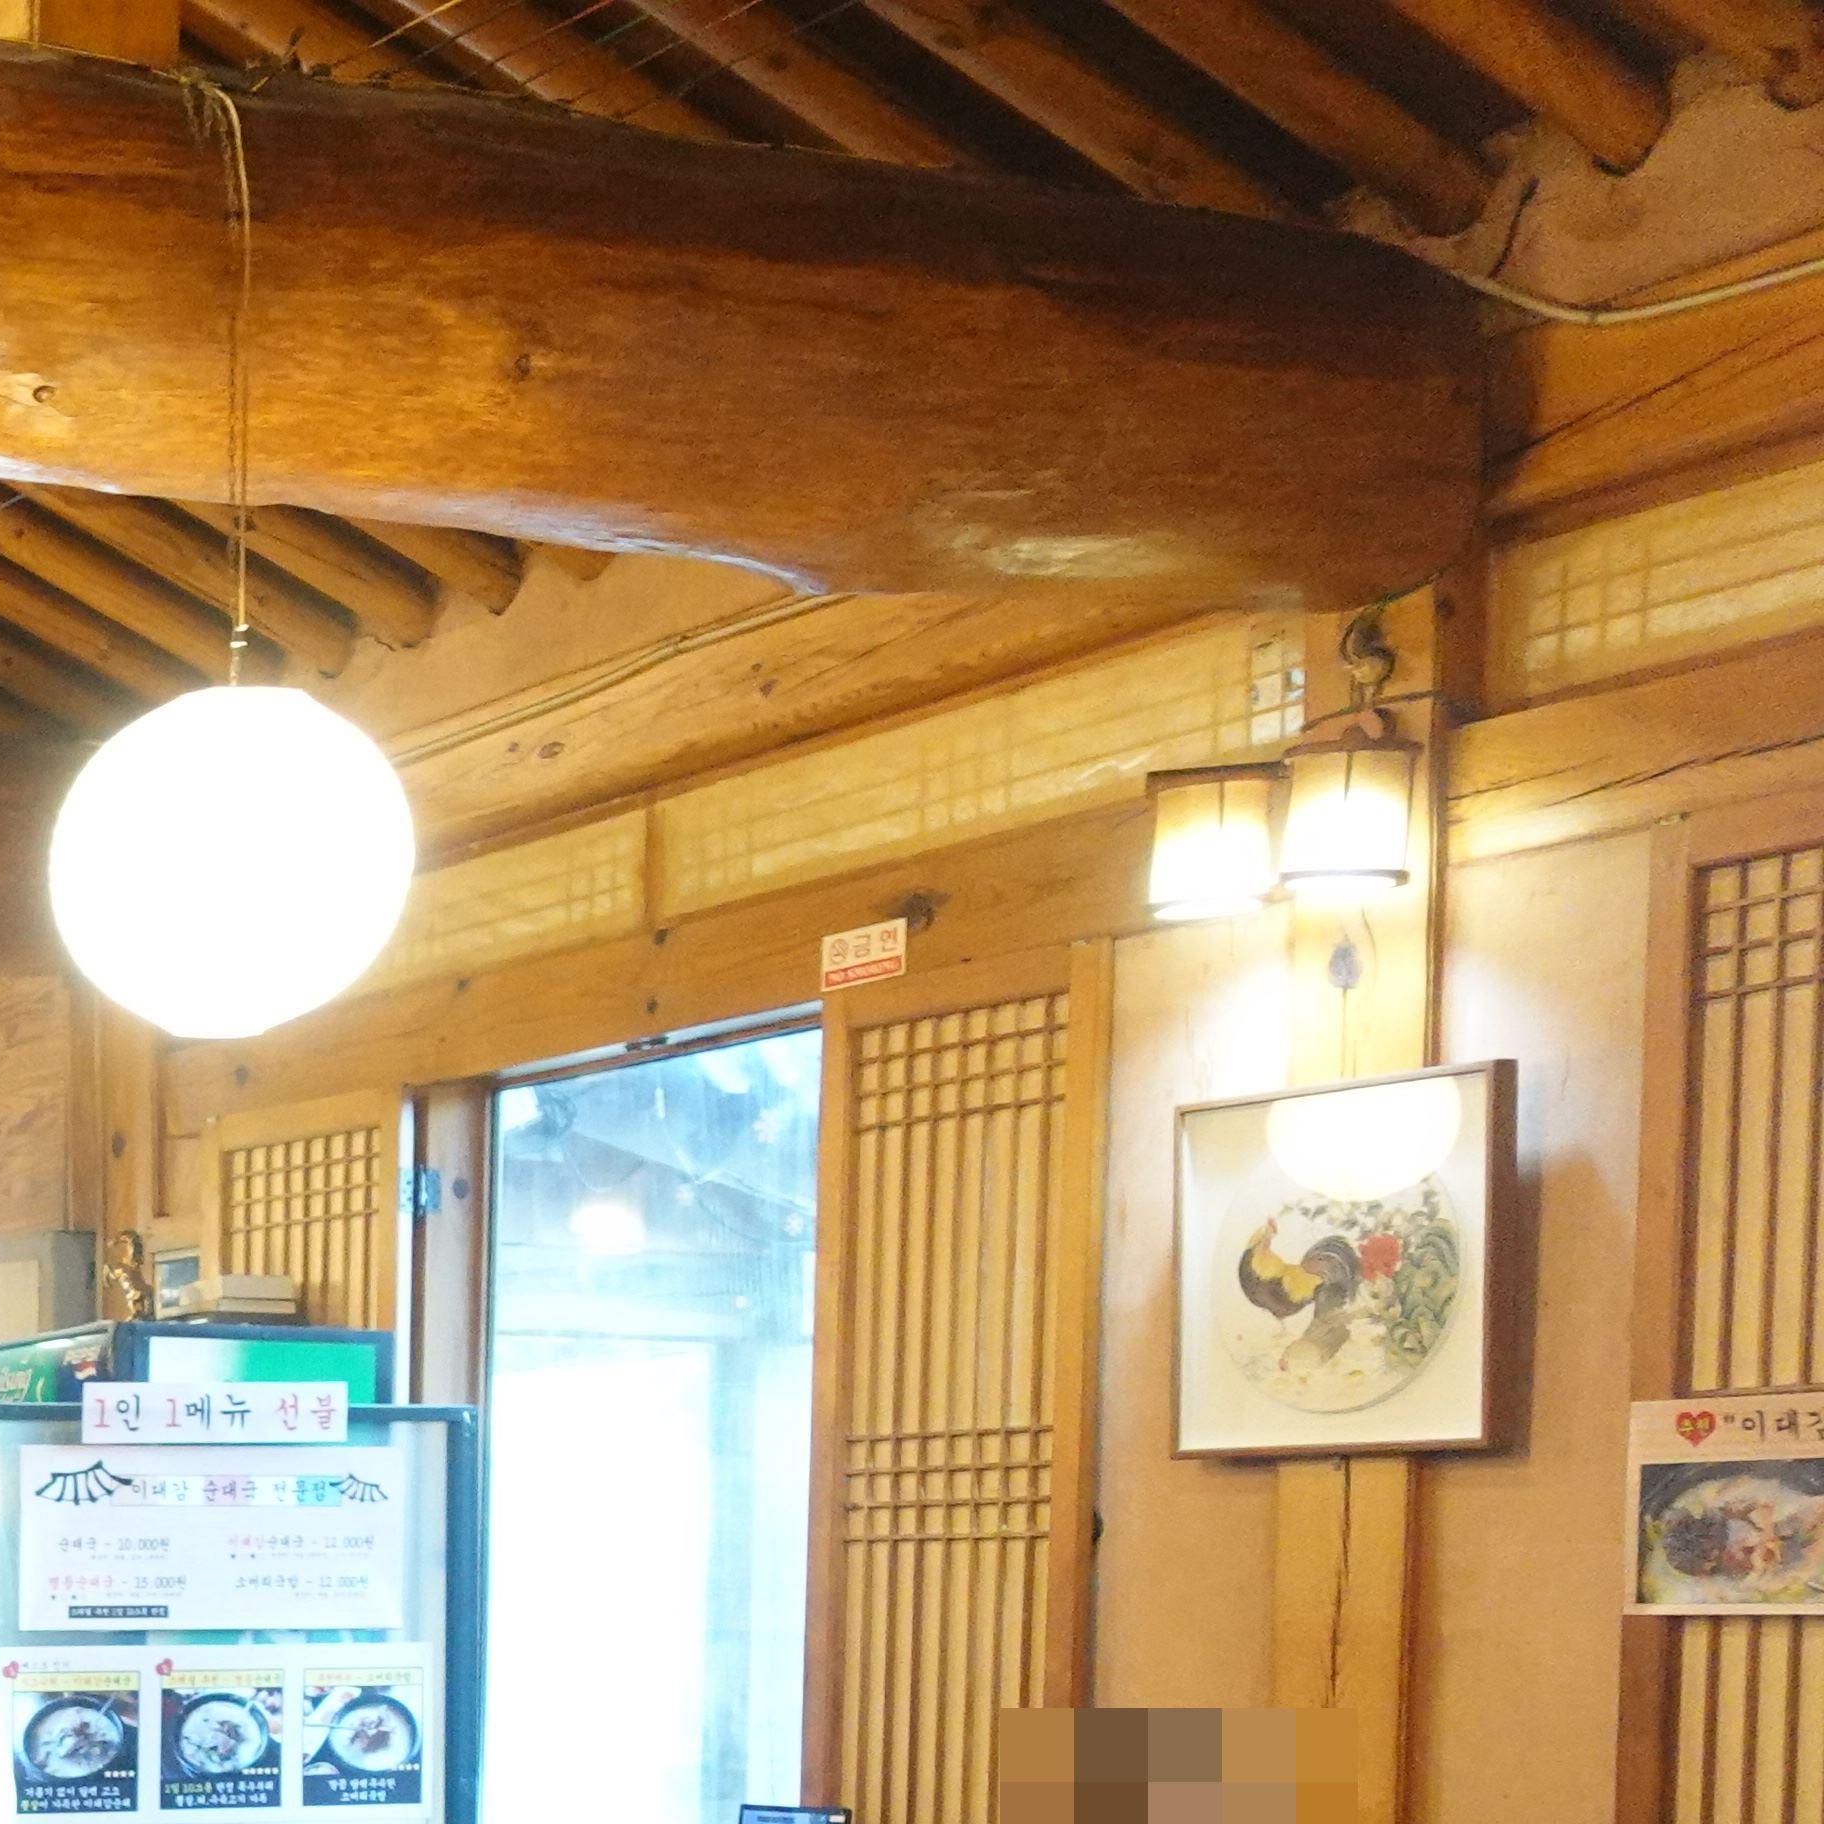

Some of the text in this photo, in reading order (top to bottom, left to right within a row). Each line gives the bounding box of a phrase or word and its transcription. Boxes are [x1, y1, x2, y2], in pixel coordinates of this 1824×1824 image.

[93, 1392, 339, 1432] 1인 1메뉴 선불
[202, 1481, 258, 1501] 순대국
[272, 1480, 327, 1502] 전문점
[58, 1537, 97, 1552] 순대국
